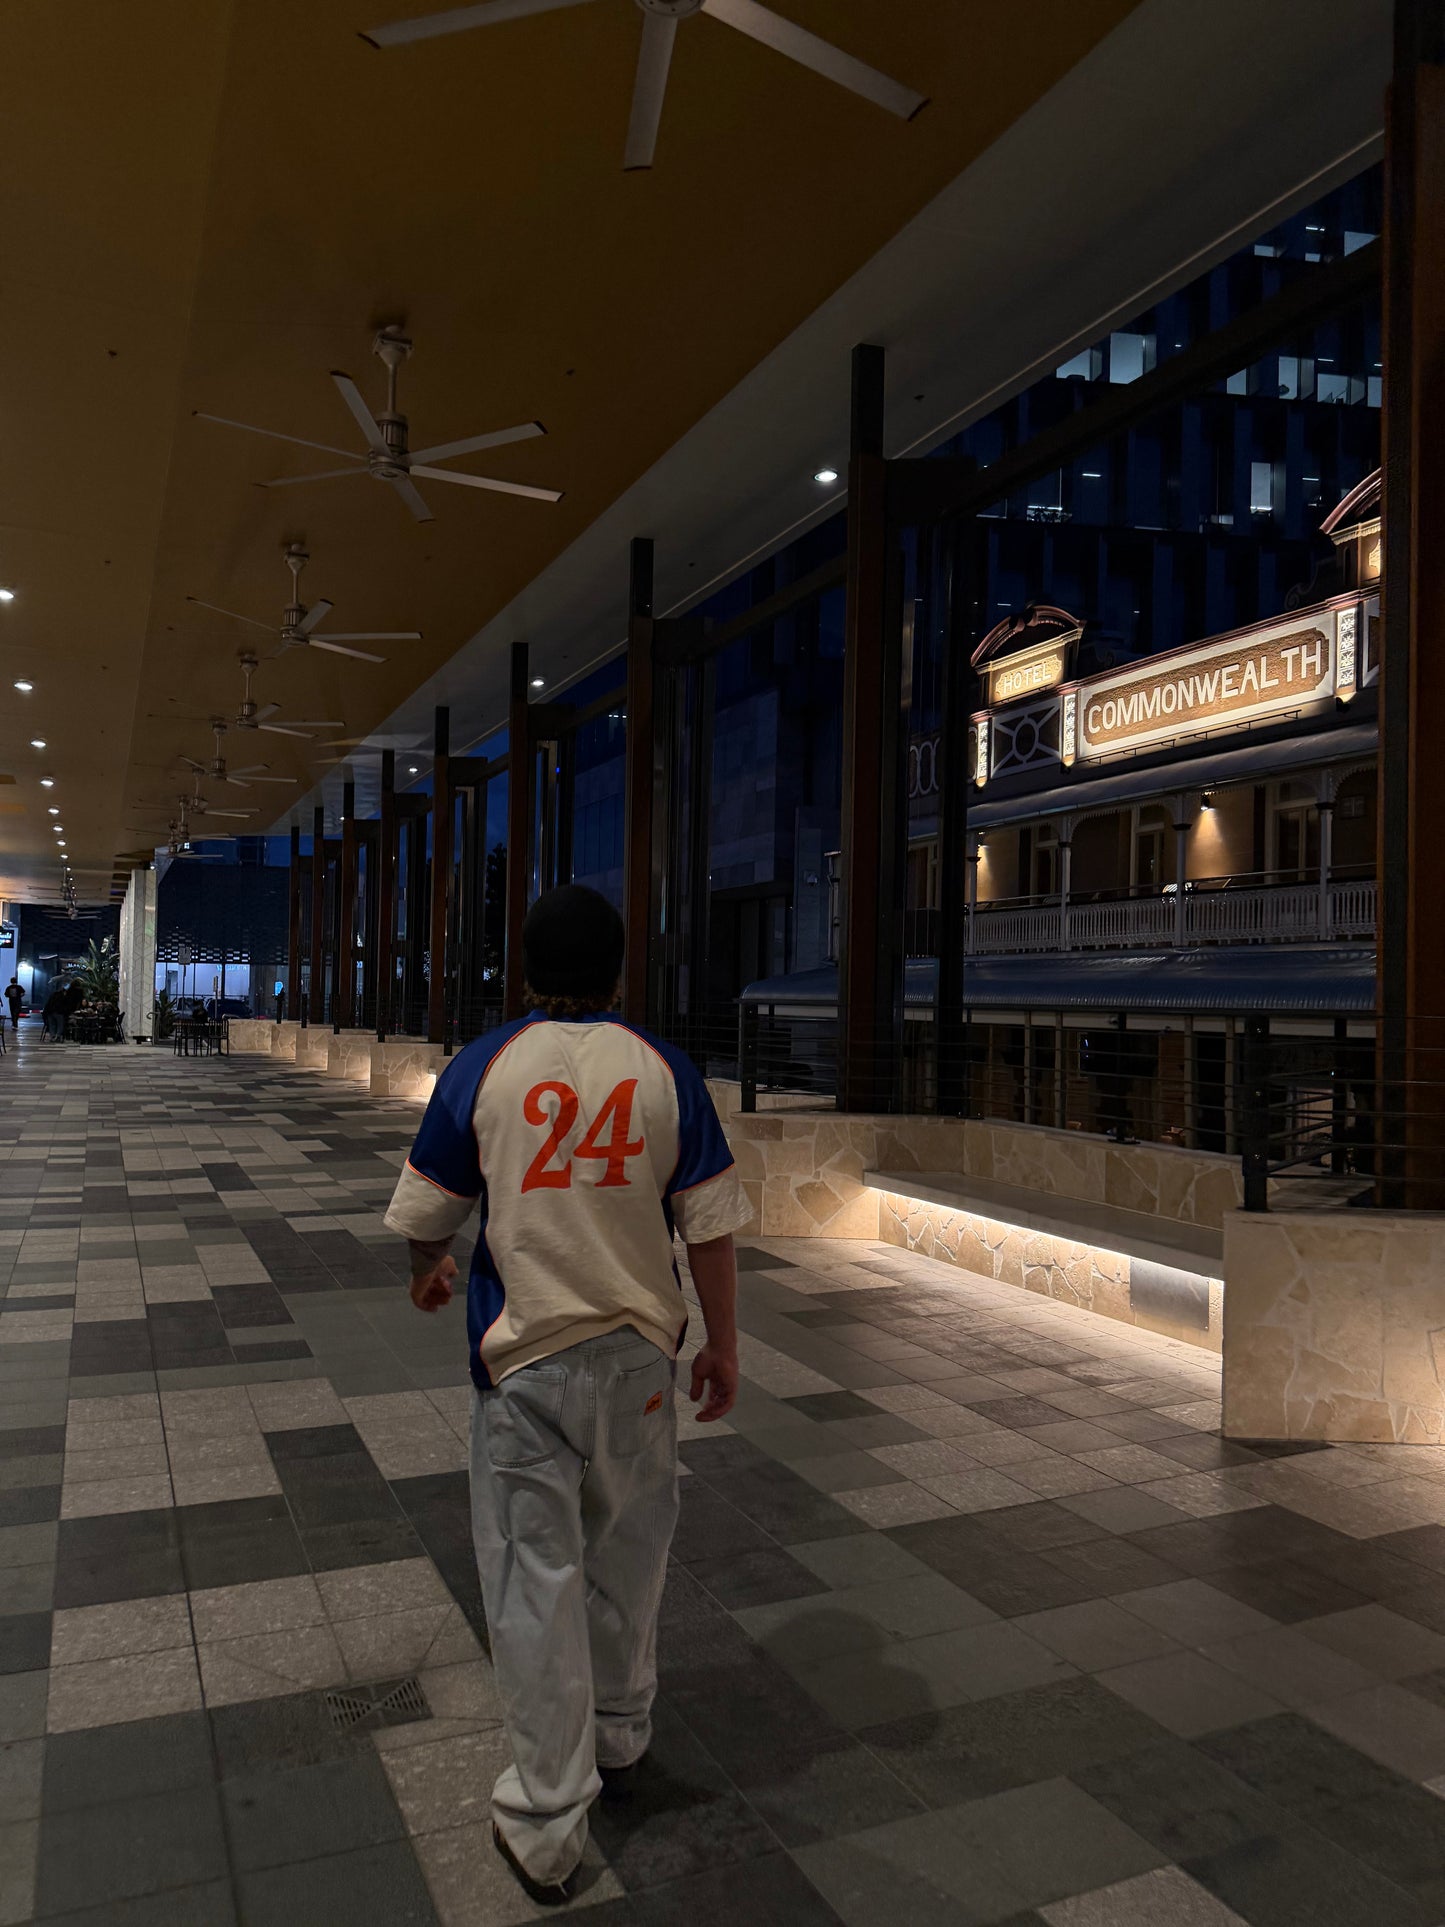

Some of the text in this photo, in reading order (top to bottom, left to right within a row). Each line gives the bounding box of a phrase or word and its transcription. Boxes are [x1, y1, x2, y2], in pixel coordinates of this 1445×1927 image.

[1003, 662, 1052, 694] HOTEL
[1088, 639, 1322, 734] COMMONWEALTH
[521, 1079, 644, 1194] 24
